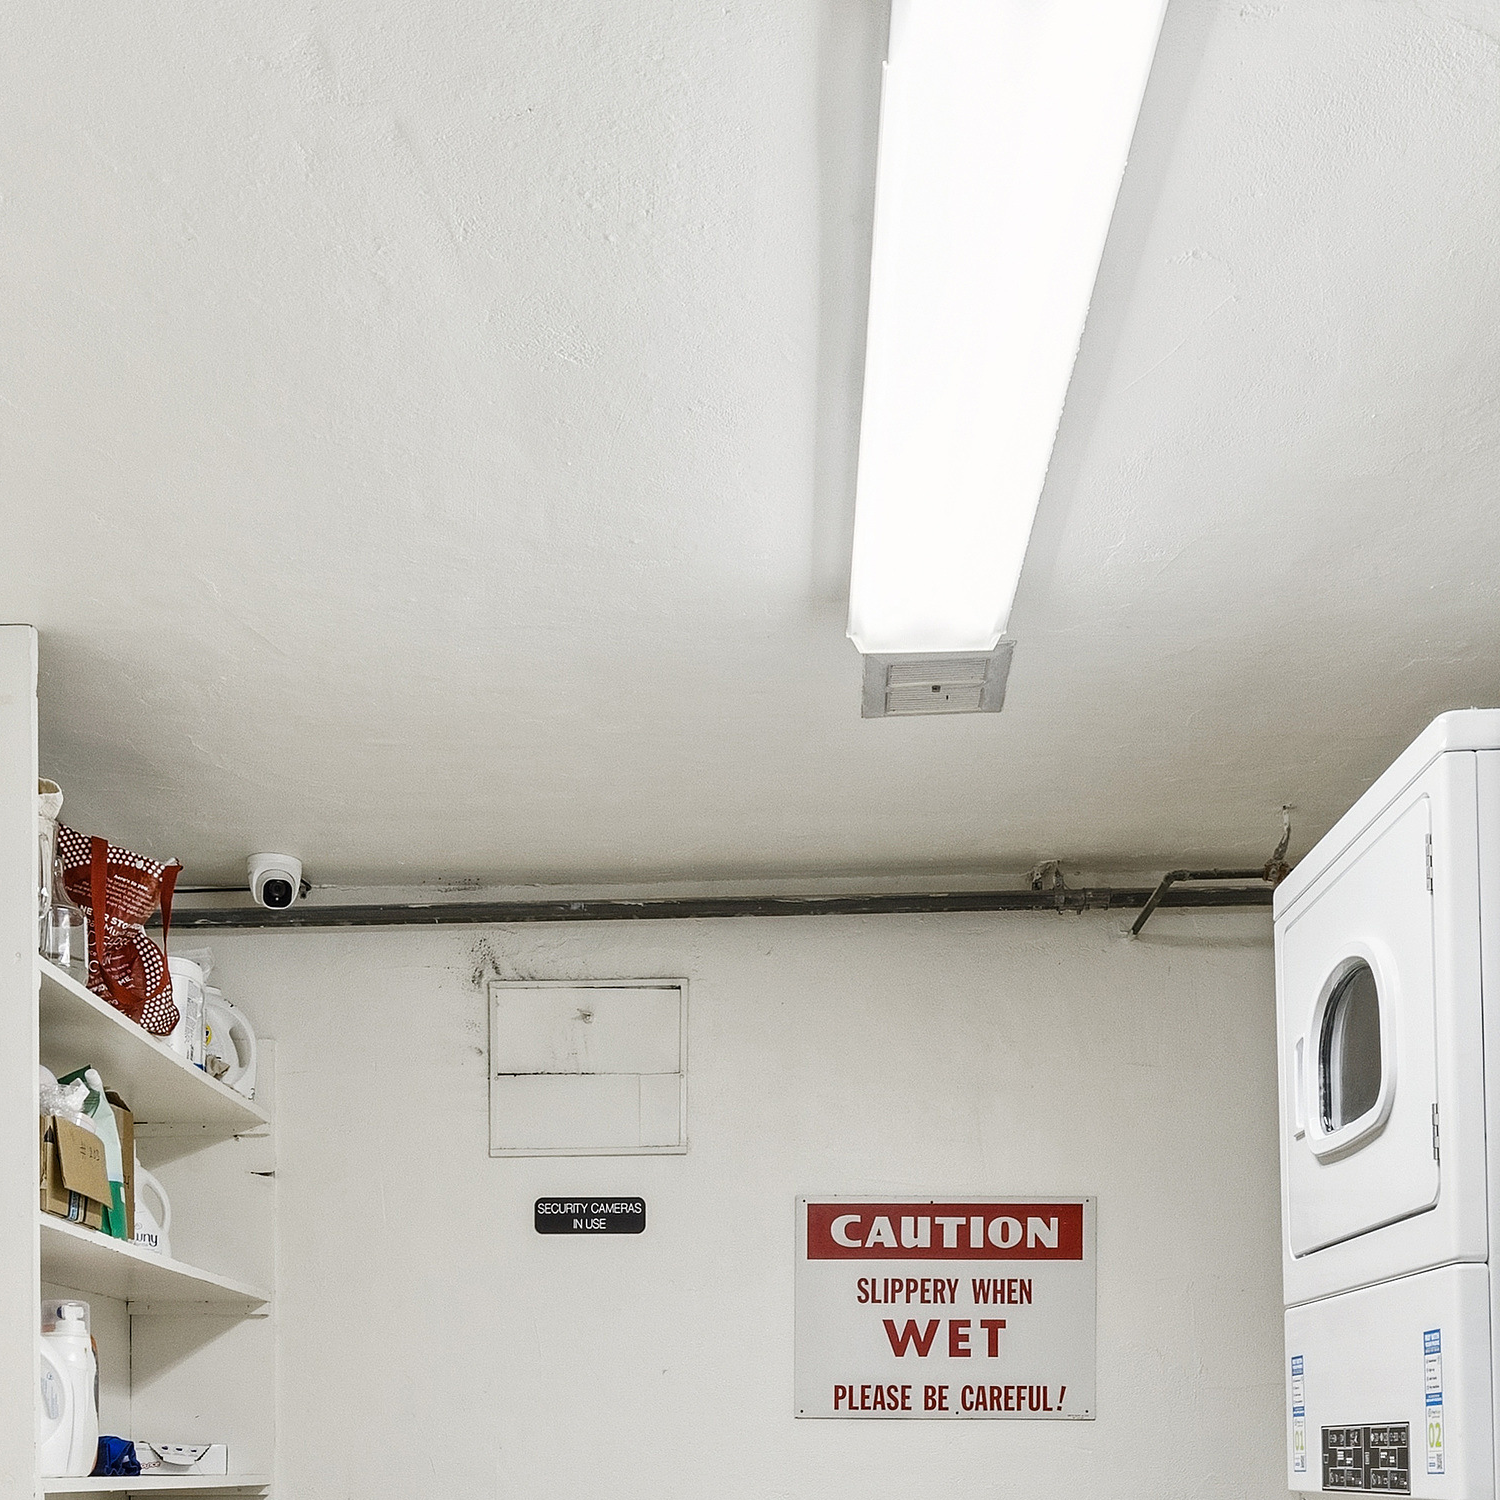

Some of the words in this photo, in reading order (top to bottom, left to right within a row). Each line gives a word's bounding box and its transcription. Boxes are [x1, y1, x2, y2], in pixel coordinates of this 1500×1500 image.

[537, 1202, 589, 1214] SECURITY
[590, 1202, 642, 1214] CAMERAS
[572, 1218, 583, 1229] IN
[585, 1218, 607, 1230] USE
[830, 1213, 1060, 1250] CAUTION
[856, 1278, 959, 1305] SLIPPERY
[971, 1278, 1033, 1304] WHEN
[882, 1319, 1007, 1358] WET
[833, 1385, 912, 1411] PLEASE
[924, 1385, 951, 1411] BE
[961, 1385, 1067, 1412] CAREFUL!
[1428, 1422, 1442, 1448] 02
